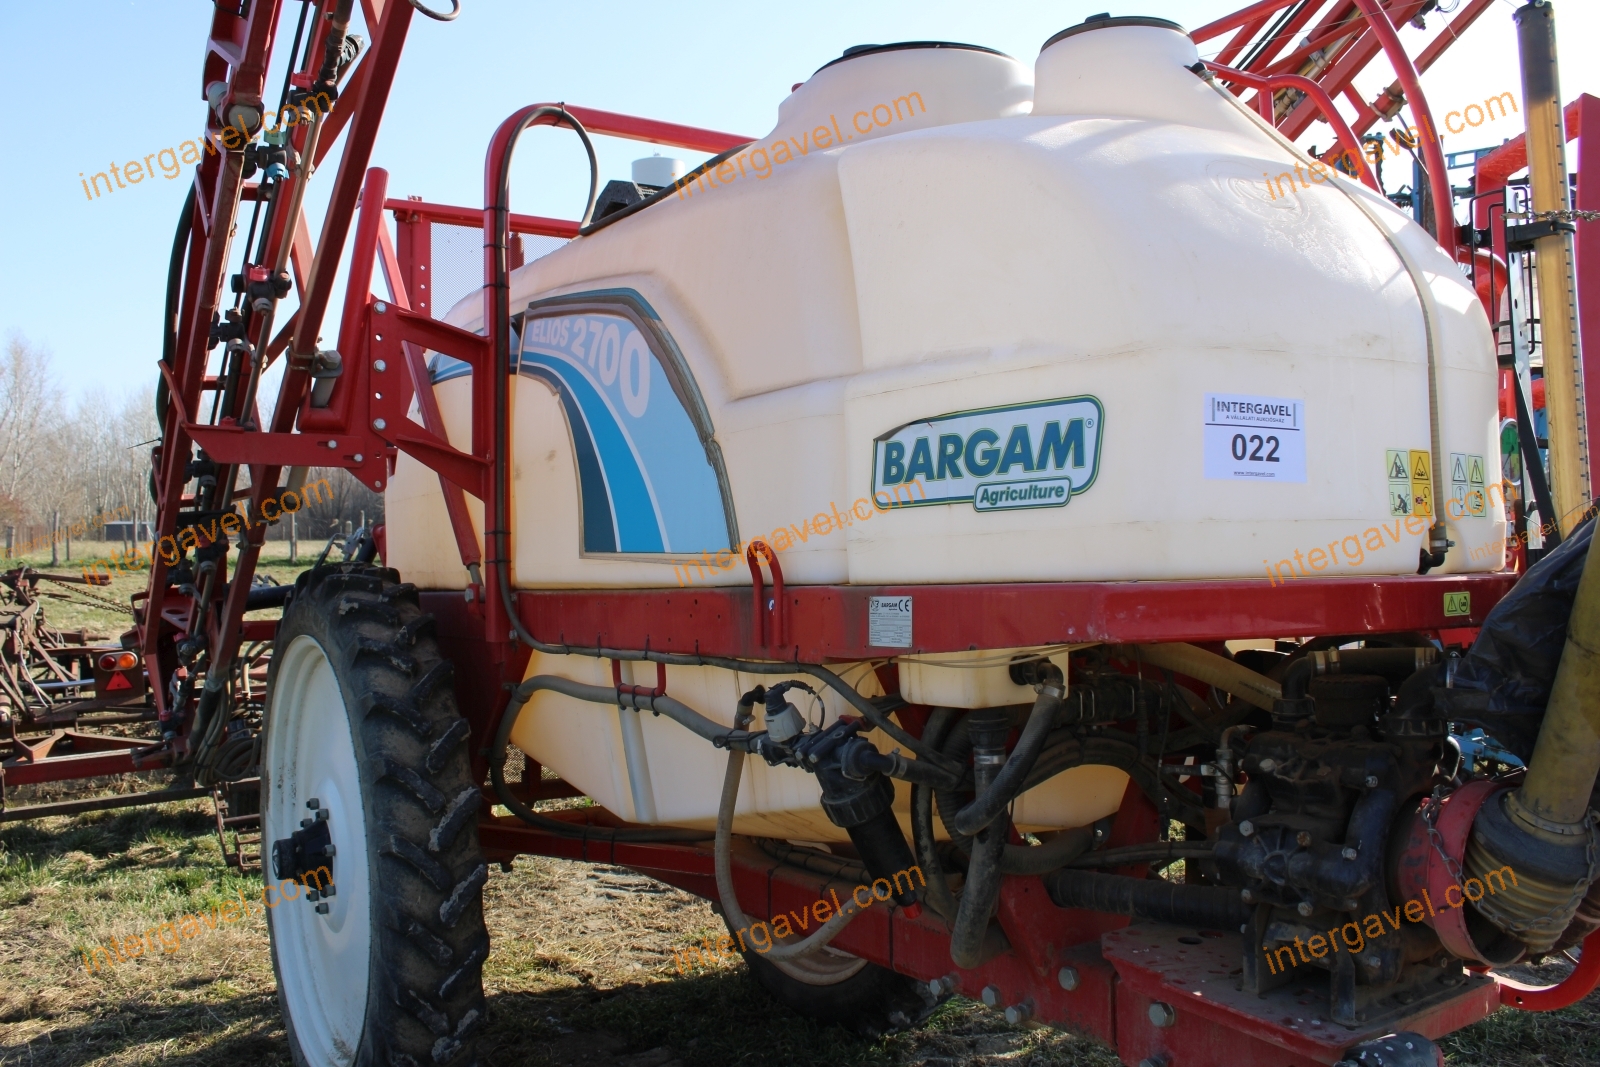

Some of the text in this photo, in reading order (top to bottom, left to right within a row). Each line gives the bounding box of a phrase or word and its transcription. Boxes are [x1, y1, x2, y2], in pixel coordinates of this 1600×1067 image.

[531, 317, 651, 419] ELIOS 2700
[1217, 401, 1291, 416] INTERGAVEL
[1231, 433, 1280, 462] 022
[979, 483, 1066, 506] Agriculture
